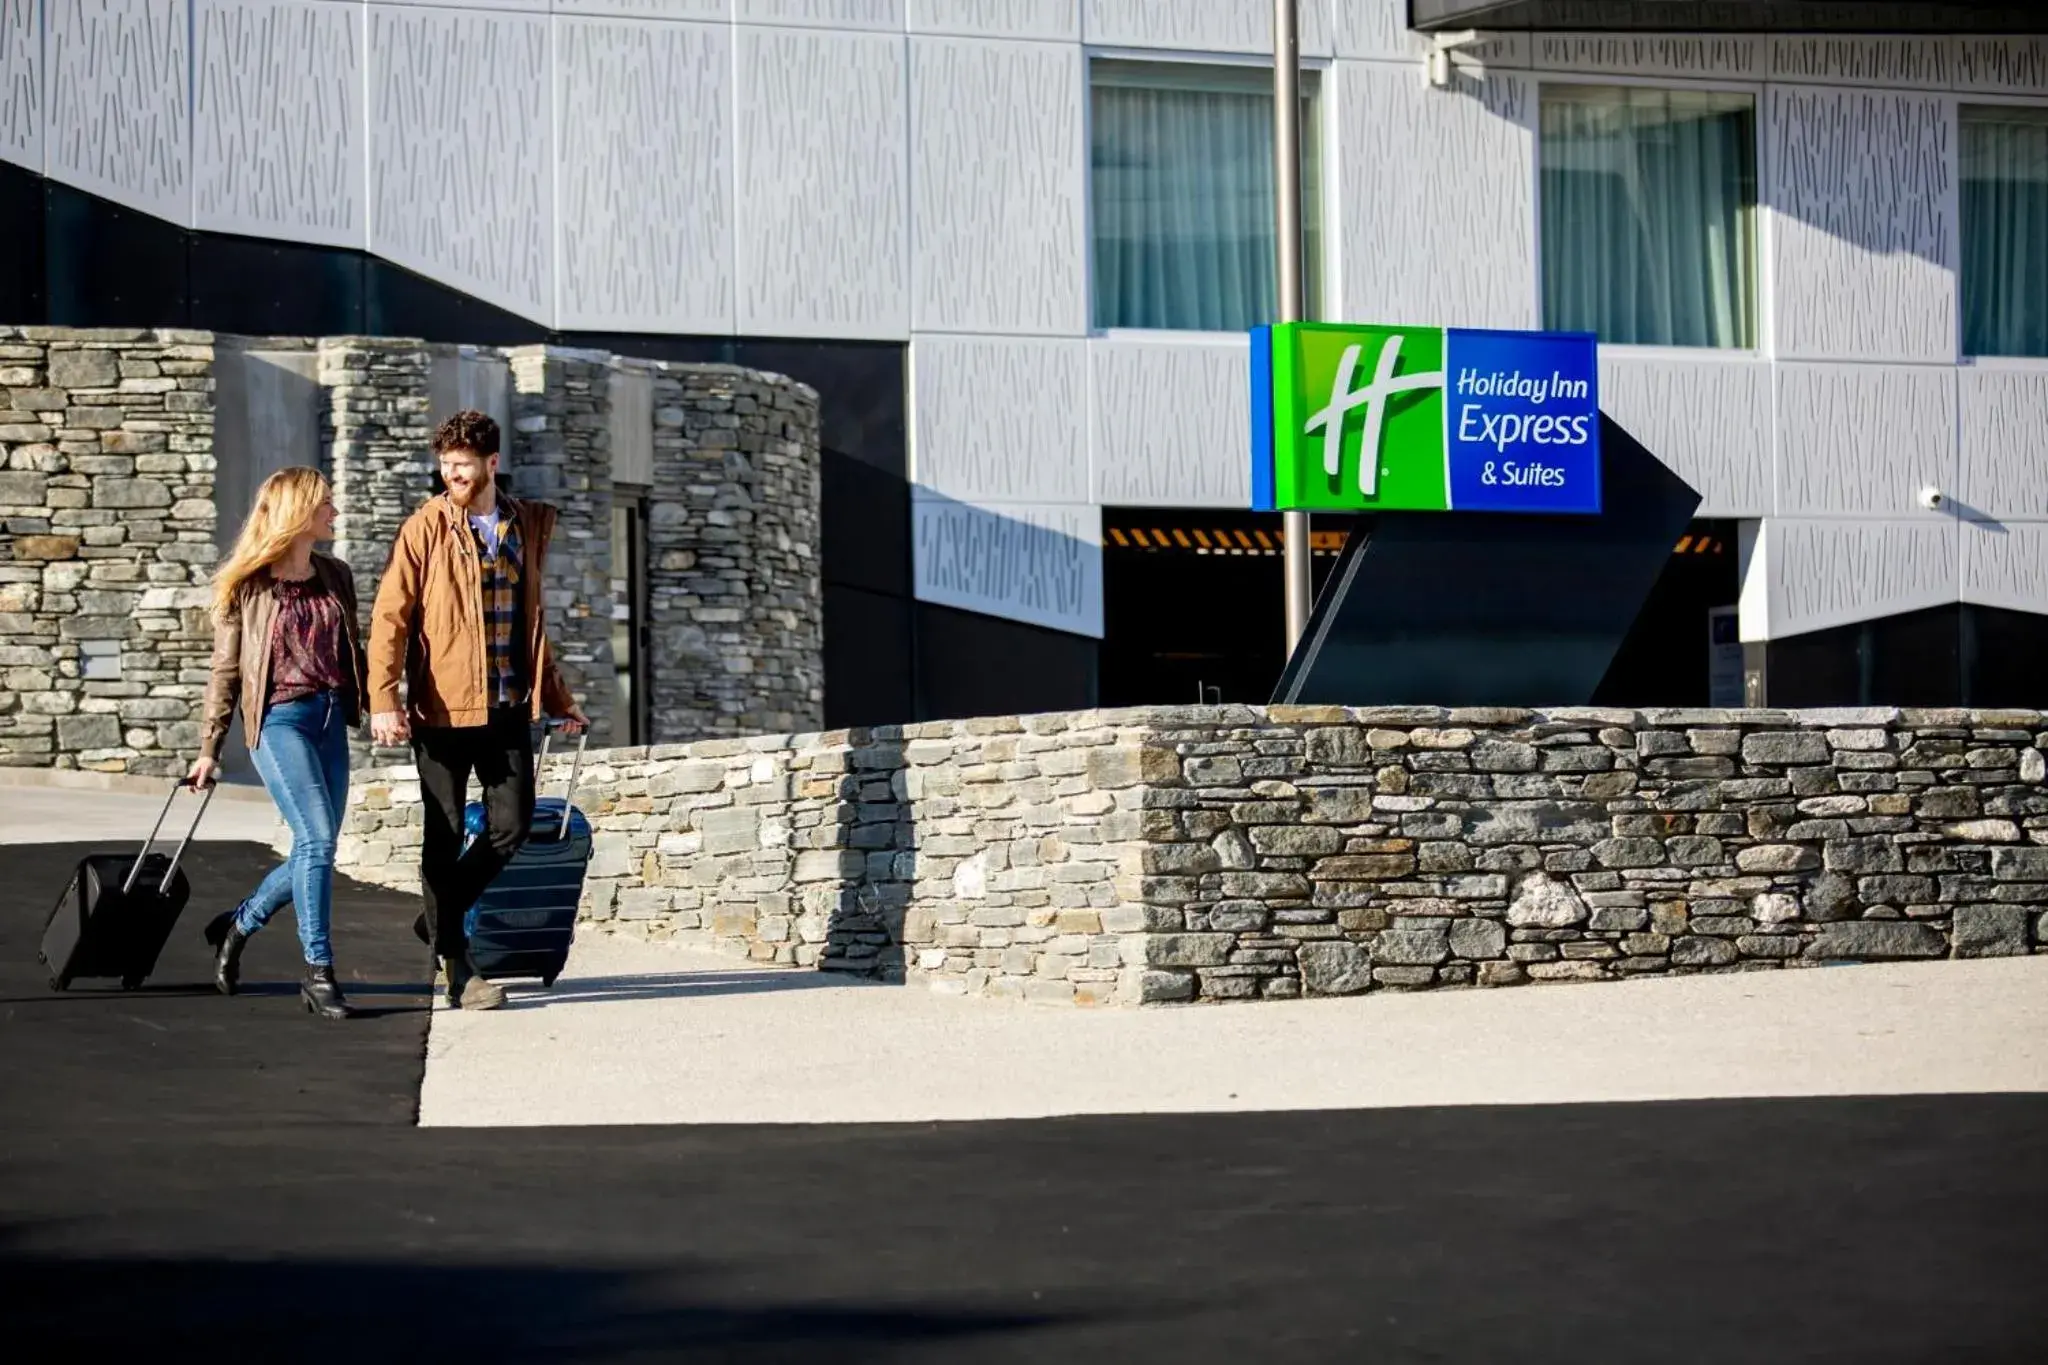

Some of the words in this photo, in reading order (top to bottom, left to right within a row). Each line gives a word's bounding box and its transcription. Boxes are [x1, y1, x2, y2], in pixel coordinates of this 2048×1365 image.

[1457, 367, 1548, 404] Holiday
[1550, 370, 1588, 399] Inn
[1458, 403, 1589, 453] Express
[1481, 460, 1497, 485] &
[1501, 460, 1565, 487] Suites
